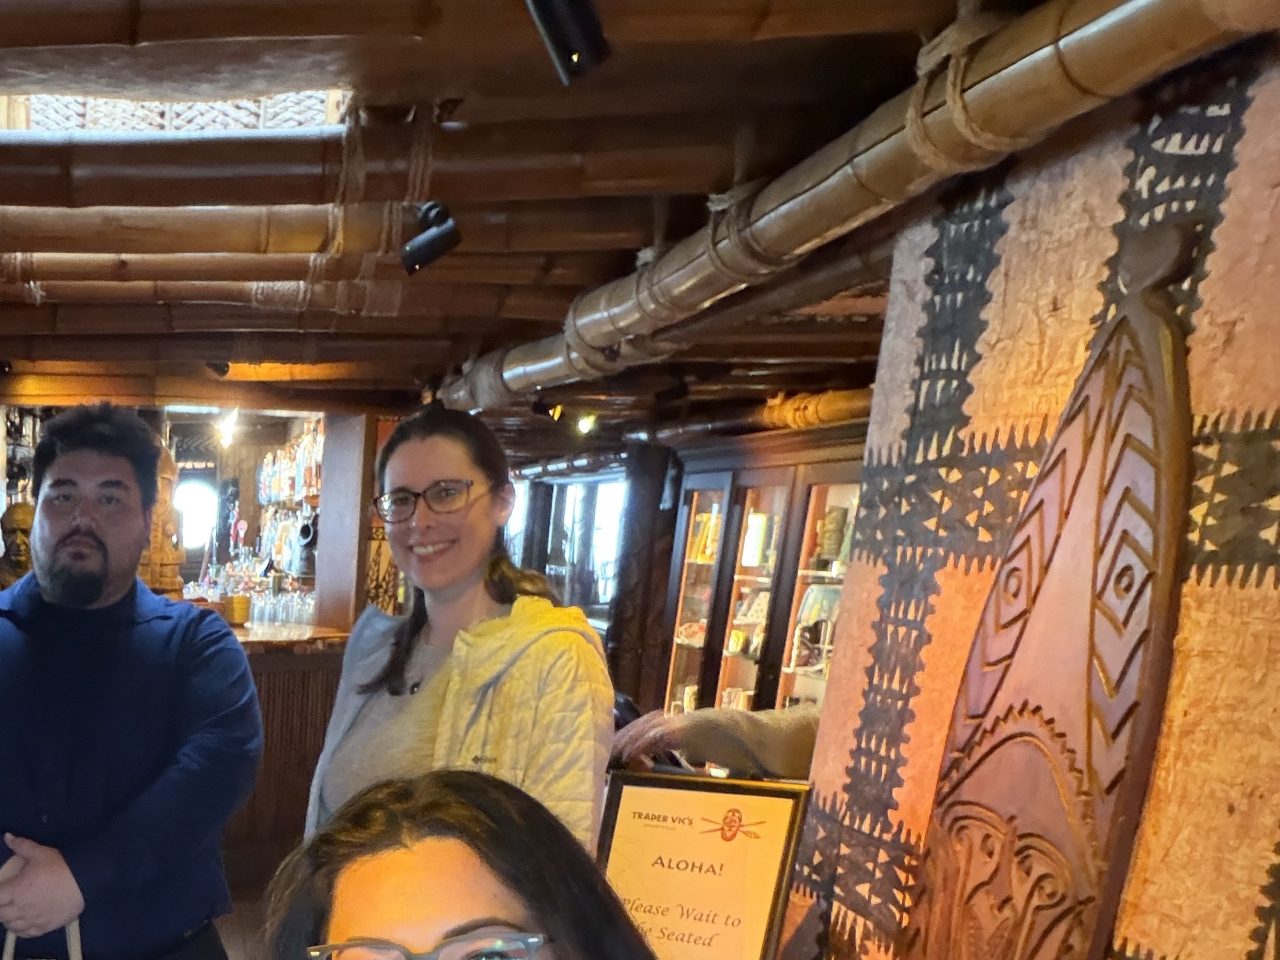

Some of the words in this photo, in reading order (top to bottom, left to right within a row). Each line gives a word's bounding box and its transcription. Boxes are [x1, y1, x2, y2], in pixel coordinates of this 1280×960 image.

[632, 811, 669, 822] TRADER
[671, 815, 693, 826] VIC'S
[651, 855, 724, 876] ALOHA!
[676, 904, 721, 924] Wait
[724, 914, 742, 928] to
[657, 926, 720, 947] Seated
